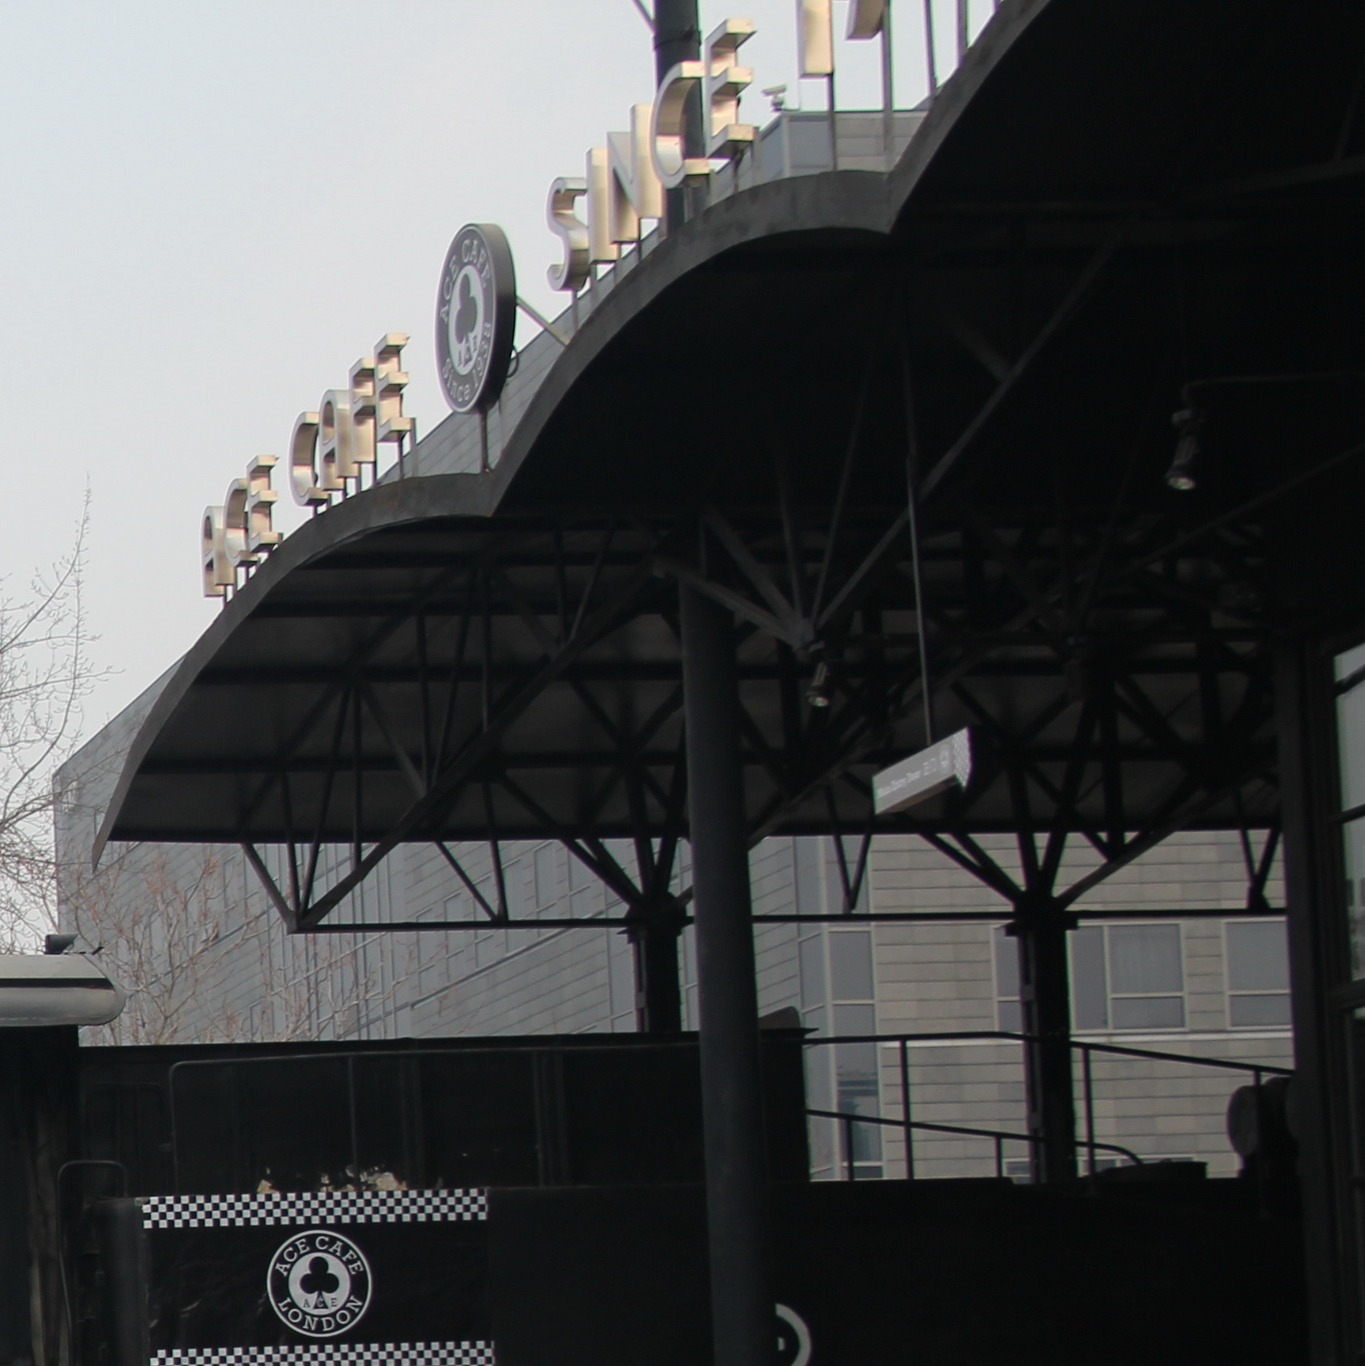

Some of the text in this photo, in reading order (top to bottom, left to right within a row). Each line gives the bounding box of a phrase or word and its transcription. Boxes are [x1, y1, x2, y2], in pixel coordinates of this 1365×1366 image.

[546, 18, 757, 291] SINCE
[440, 239, 491, 325] ACE CAFE
[443, 358, 470, 402] Since
[200, 333, 412, 597] ACE CAFE
[275, 1236, 364, 1276] ACE CAFE
[278, 1295, 363, 1331] LONDON
[303, 1297, 337, 1308] ACE
